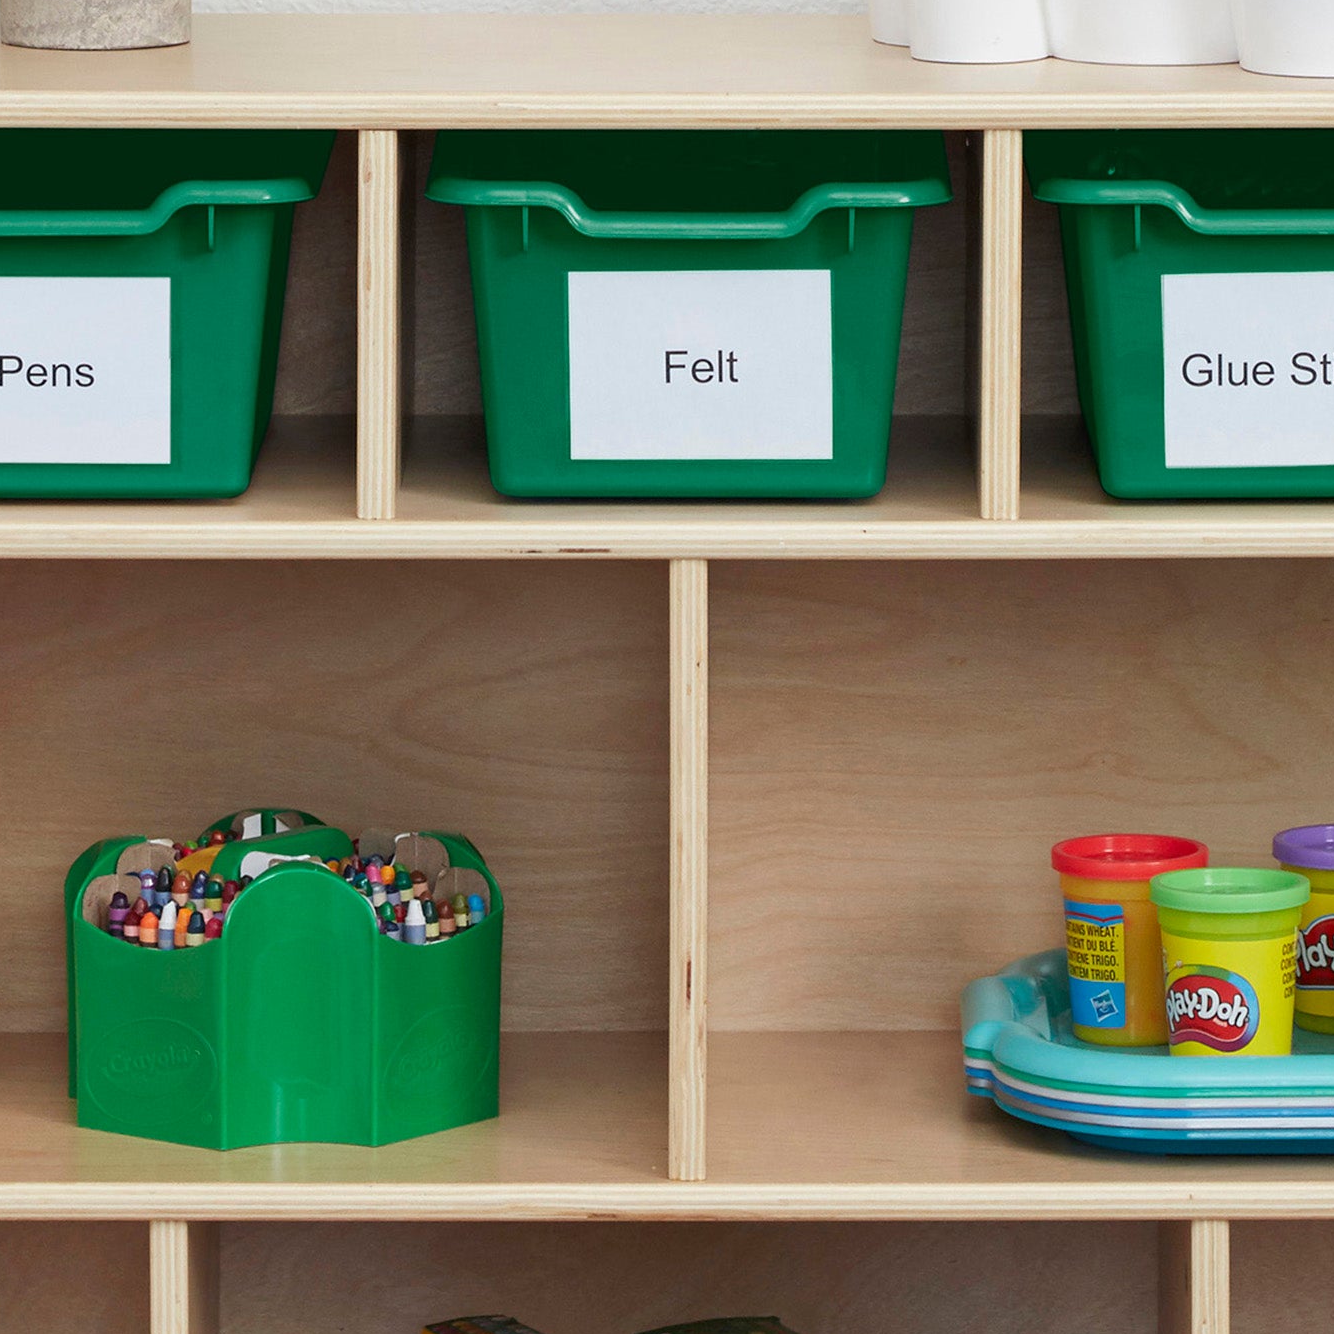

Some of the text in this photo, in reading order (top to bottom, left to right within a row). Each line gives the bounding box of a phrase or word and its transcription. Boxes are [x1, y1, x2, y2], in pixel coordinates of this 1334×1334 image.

[665, 349, 739, 384] Felt
[1182, 352, 1275, 387] Glue
[1086, 925, 1119, 938] WHEAT.
[1087, 939, 1097, 951] DU
[1091, 953, 1119, 966] TRIGO.
[1091, 968, 1119, 981] TRIGO.
